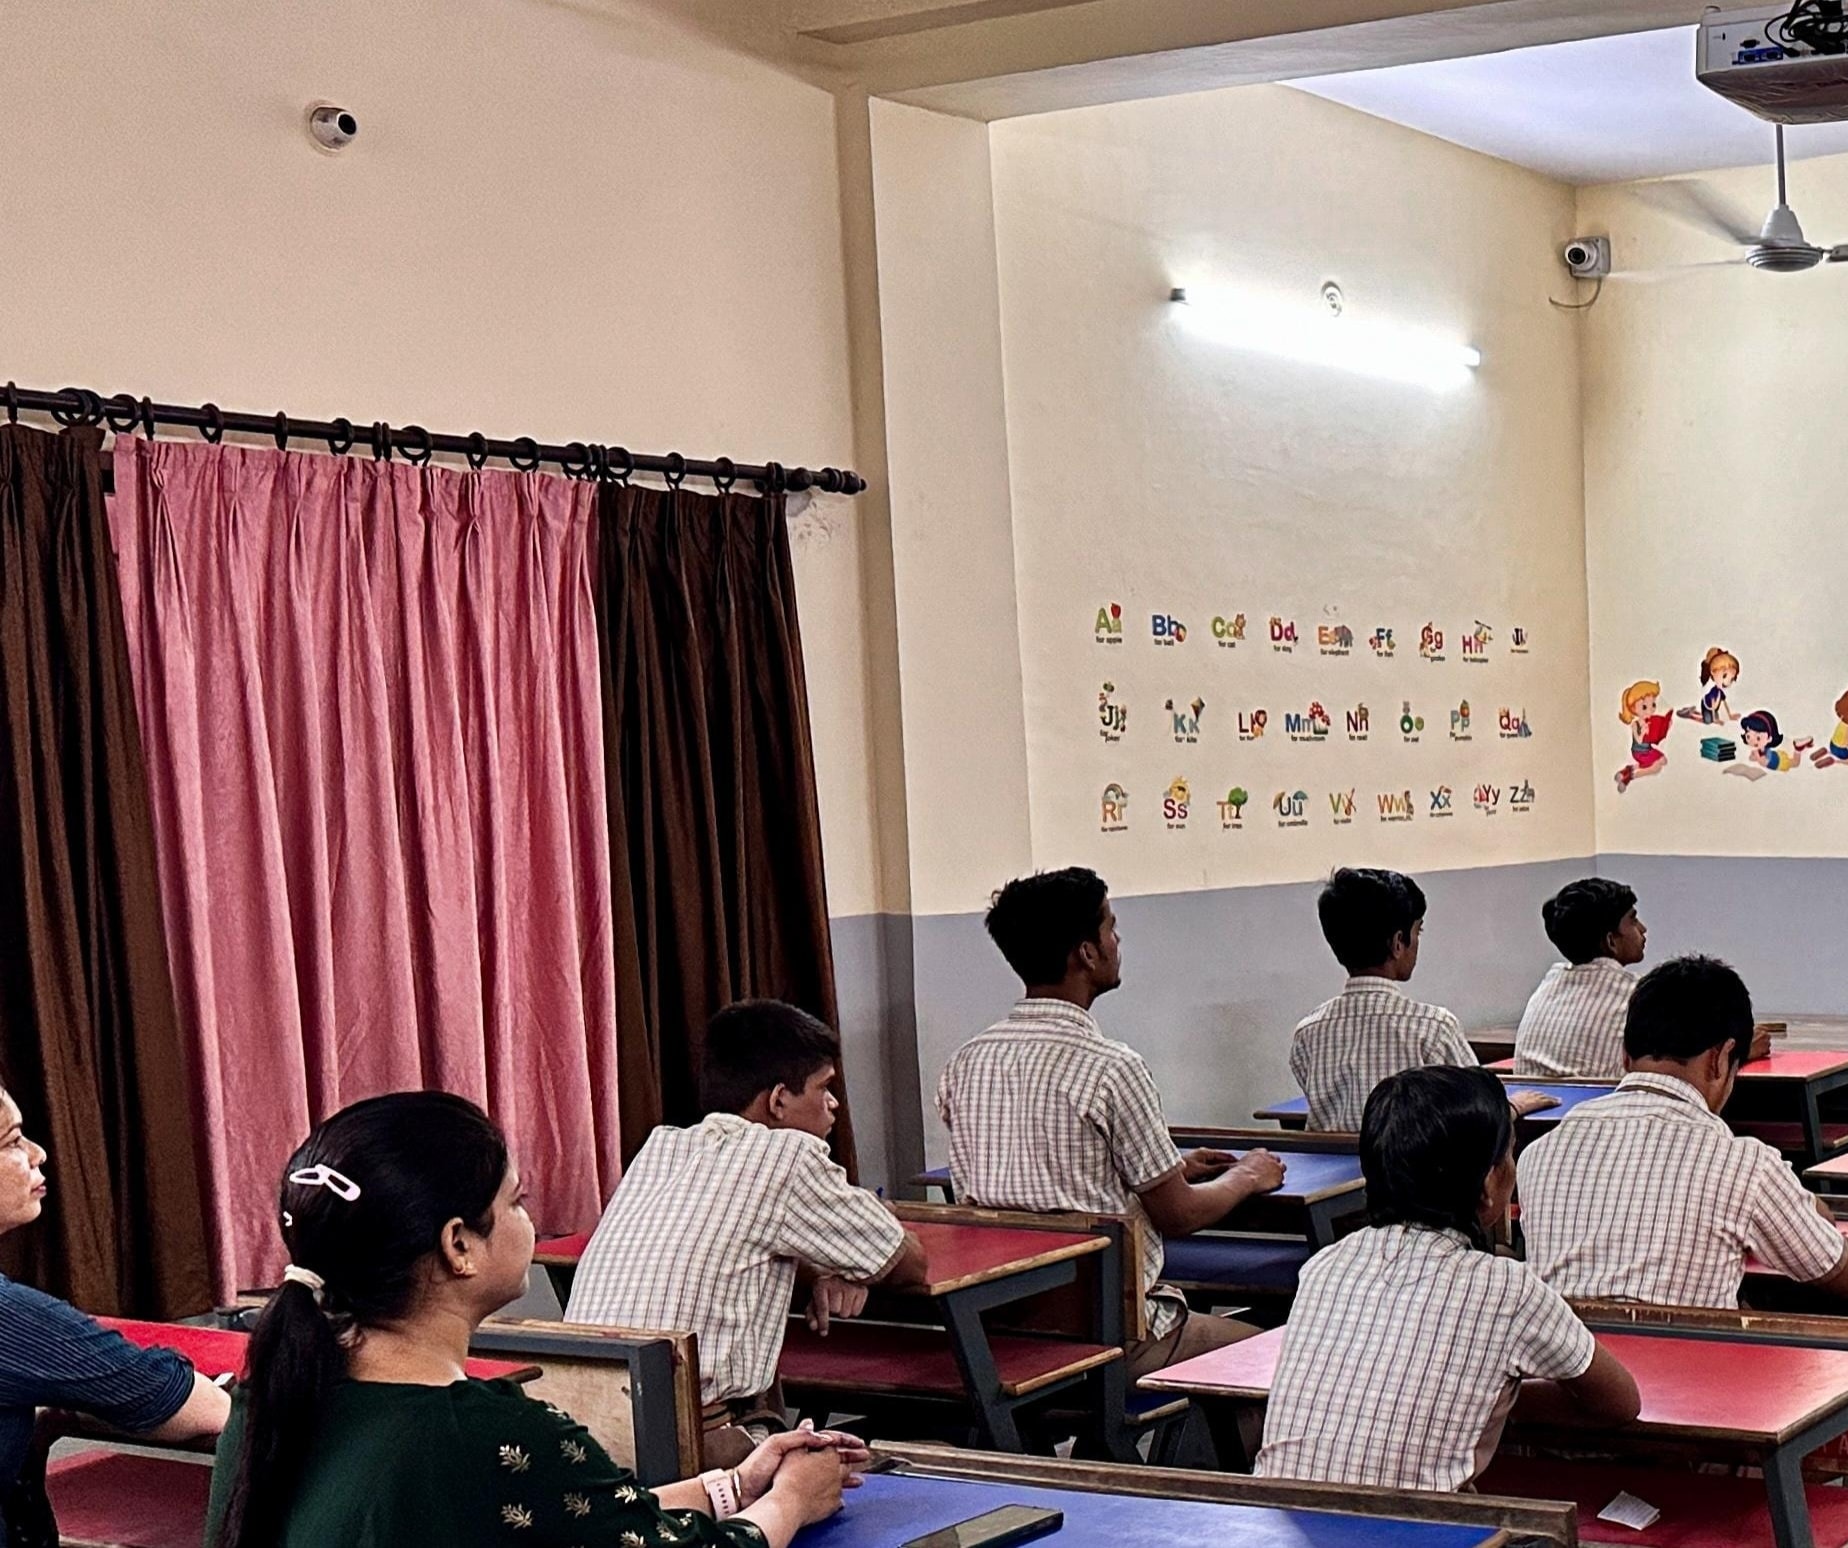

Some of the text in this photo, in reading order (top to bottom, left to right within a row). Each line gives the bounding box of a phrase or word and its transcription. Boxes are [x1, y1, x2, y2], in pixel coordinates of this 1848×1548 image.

[1152, 615, 1181, 636] Bb
[1270, 621, 1295, 641] Dd
[1421, 626, 1443, 649] Gg
[1483, 784, 1500, 805] Yy
[1164, 799, 1188, 819] Ss
